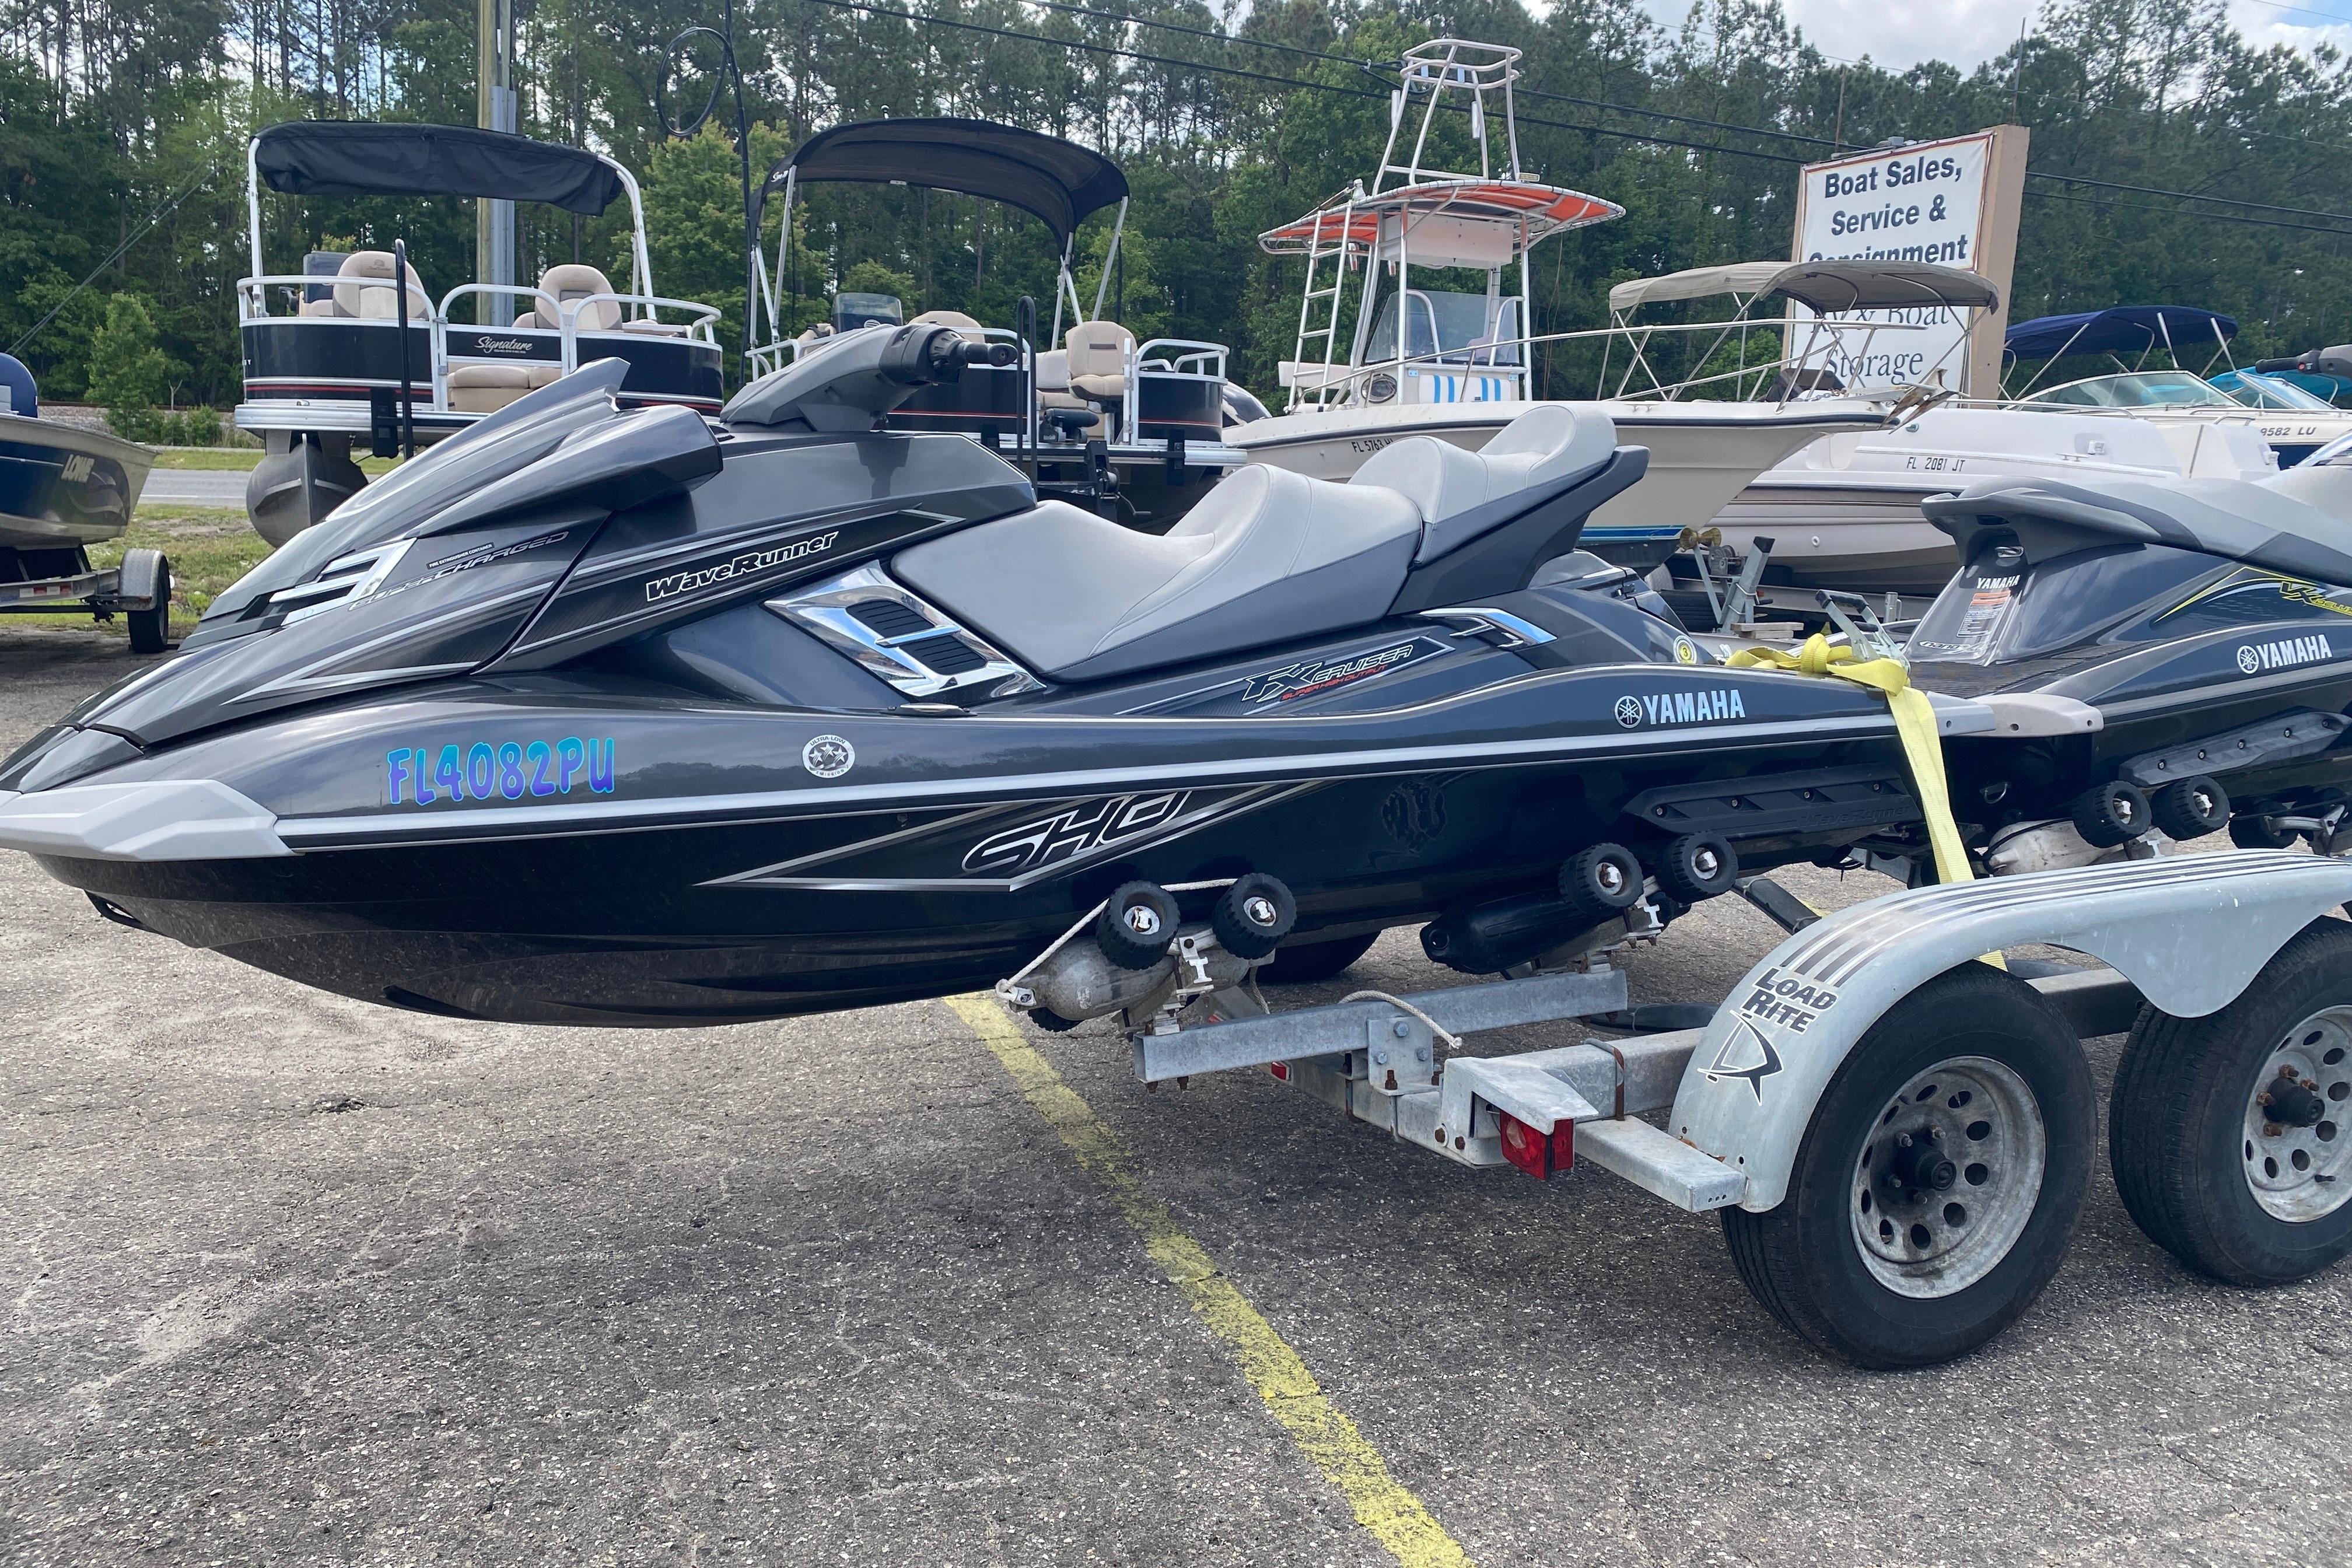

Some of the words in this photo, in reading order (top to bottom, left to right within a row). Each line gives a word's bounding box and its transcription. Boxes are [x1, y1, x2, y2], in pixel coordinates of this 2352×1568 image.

[1825, 167, 1878, 198] Boat
[1885, 156, 1962, 188] Sales,
[1832, 203, 1919, 236] Service
[1929, 194, 1946, 222] &
[1809, 235, 1968, 262] inment
[474, 336, 533, 354] Signature
[1826, 348, 1923, 385] Storage
[1351, 441, 1364, 453] FL
[1364, 439, 1384, 452] 5763
[2260, 427, 2291, 436] 9582
[2297, 427, 2317, 435] LU
[1906, 457, 1917, 469] FL
[1924, 457, 1948, 471] 2081
[1952, 459, 1966, 472] JT
[349, 531, 569, 611] SUPERCHARGED
[439, 551, 469, 565] EXTINGUISHER
[468, 544, 493, 555] CONTAINER
[646, 531, 839, 601] WaveRunner
[1976, 575, 2021, 589] YAMAHA
[2279, 581, 2325, 604] VX
[1682, 648, 1688, 657] 3
[2256, 634, 2332, 669] YAMAHA
[1242, 663, 1322, 703] FX
[1311, 644, 1413, 684] CRUISER
[1281, 684, 1321, 701] SUPER
[1344, 664, 1388, 680] OUTPUT
[1642, 689, 1746, 724] YAMAHA
[387, 737, 614, 806] FL4082PU
[961, 790, 1192, 872] SHO
[1752, 967, 1838, 1012] LOAD
[1740, 988, 1818, 1035] RITE
